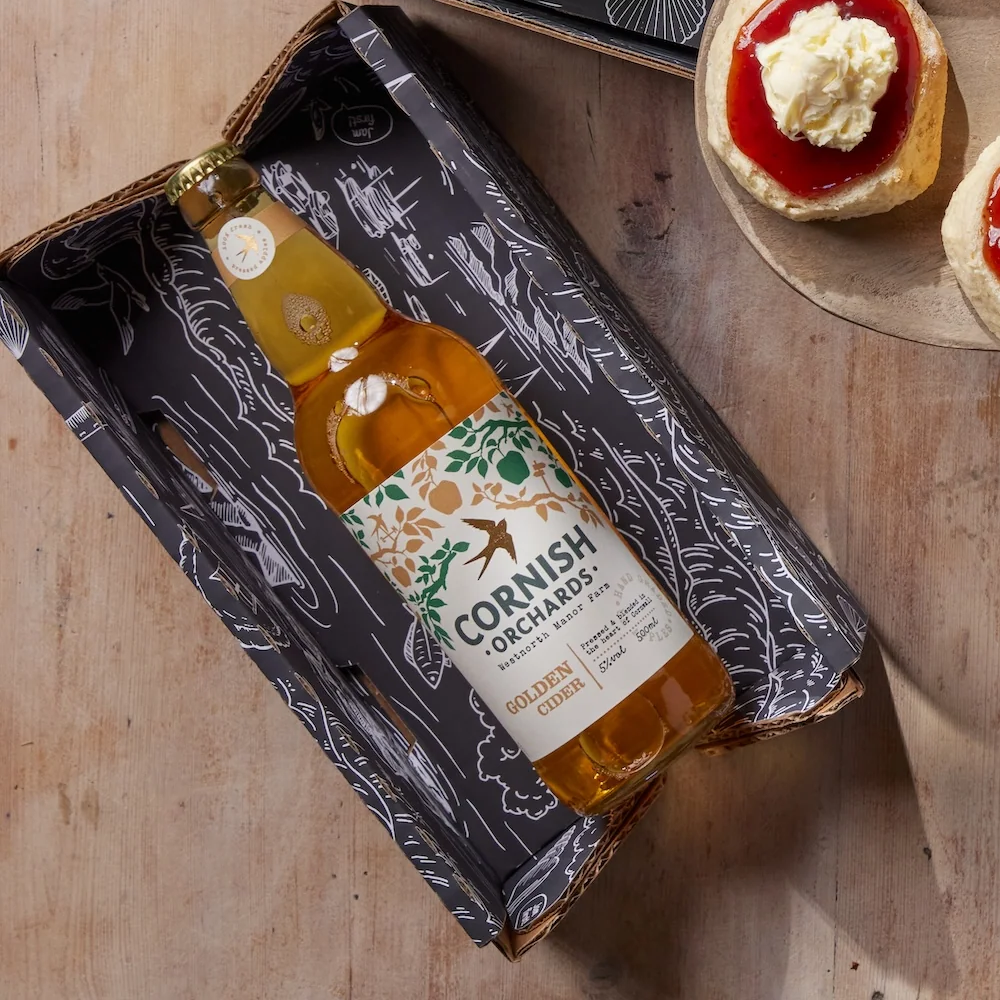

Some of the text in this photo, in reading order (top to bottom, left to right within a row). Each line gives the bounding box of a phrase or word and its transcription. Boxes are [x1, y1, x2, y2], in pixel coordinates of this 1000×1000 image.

[454, 524, 598, 646] CORNISH
[497, 631, 550, 671] Westnorth
[553, 602, 584, 631] Manor
[587, 581, 611, 603] Farm
[580, 624, 610, 650] Pressed
[616, 599, 640, 620] blended
[586, 597, 653, 656] the heart of Cornwall
[635, 616, 659, 642] 500ml
[505, 659, 575, 715] GOLDEN
[536, 676, 586, 716] CIDER
